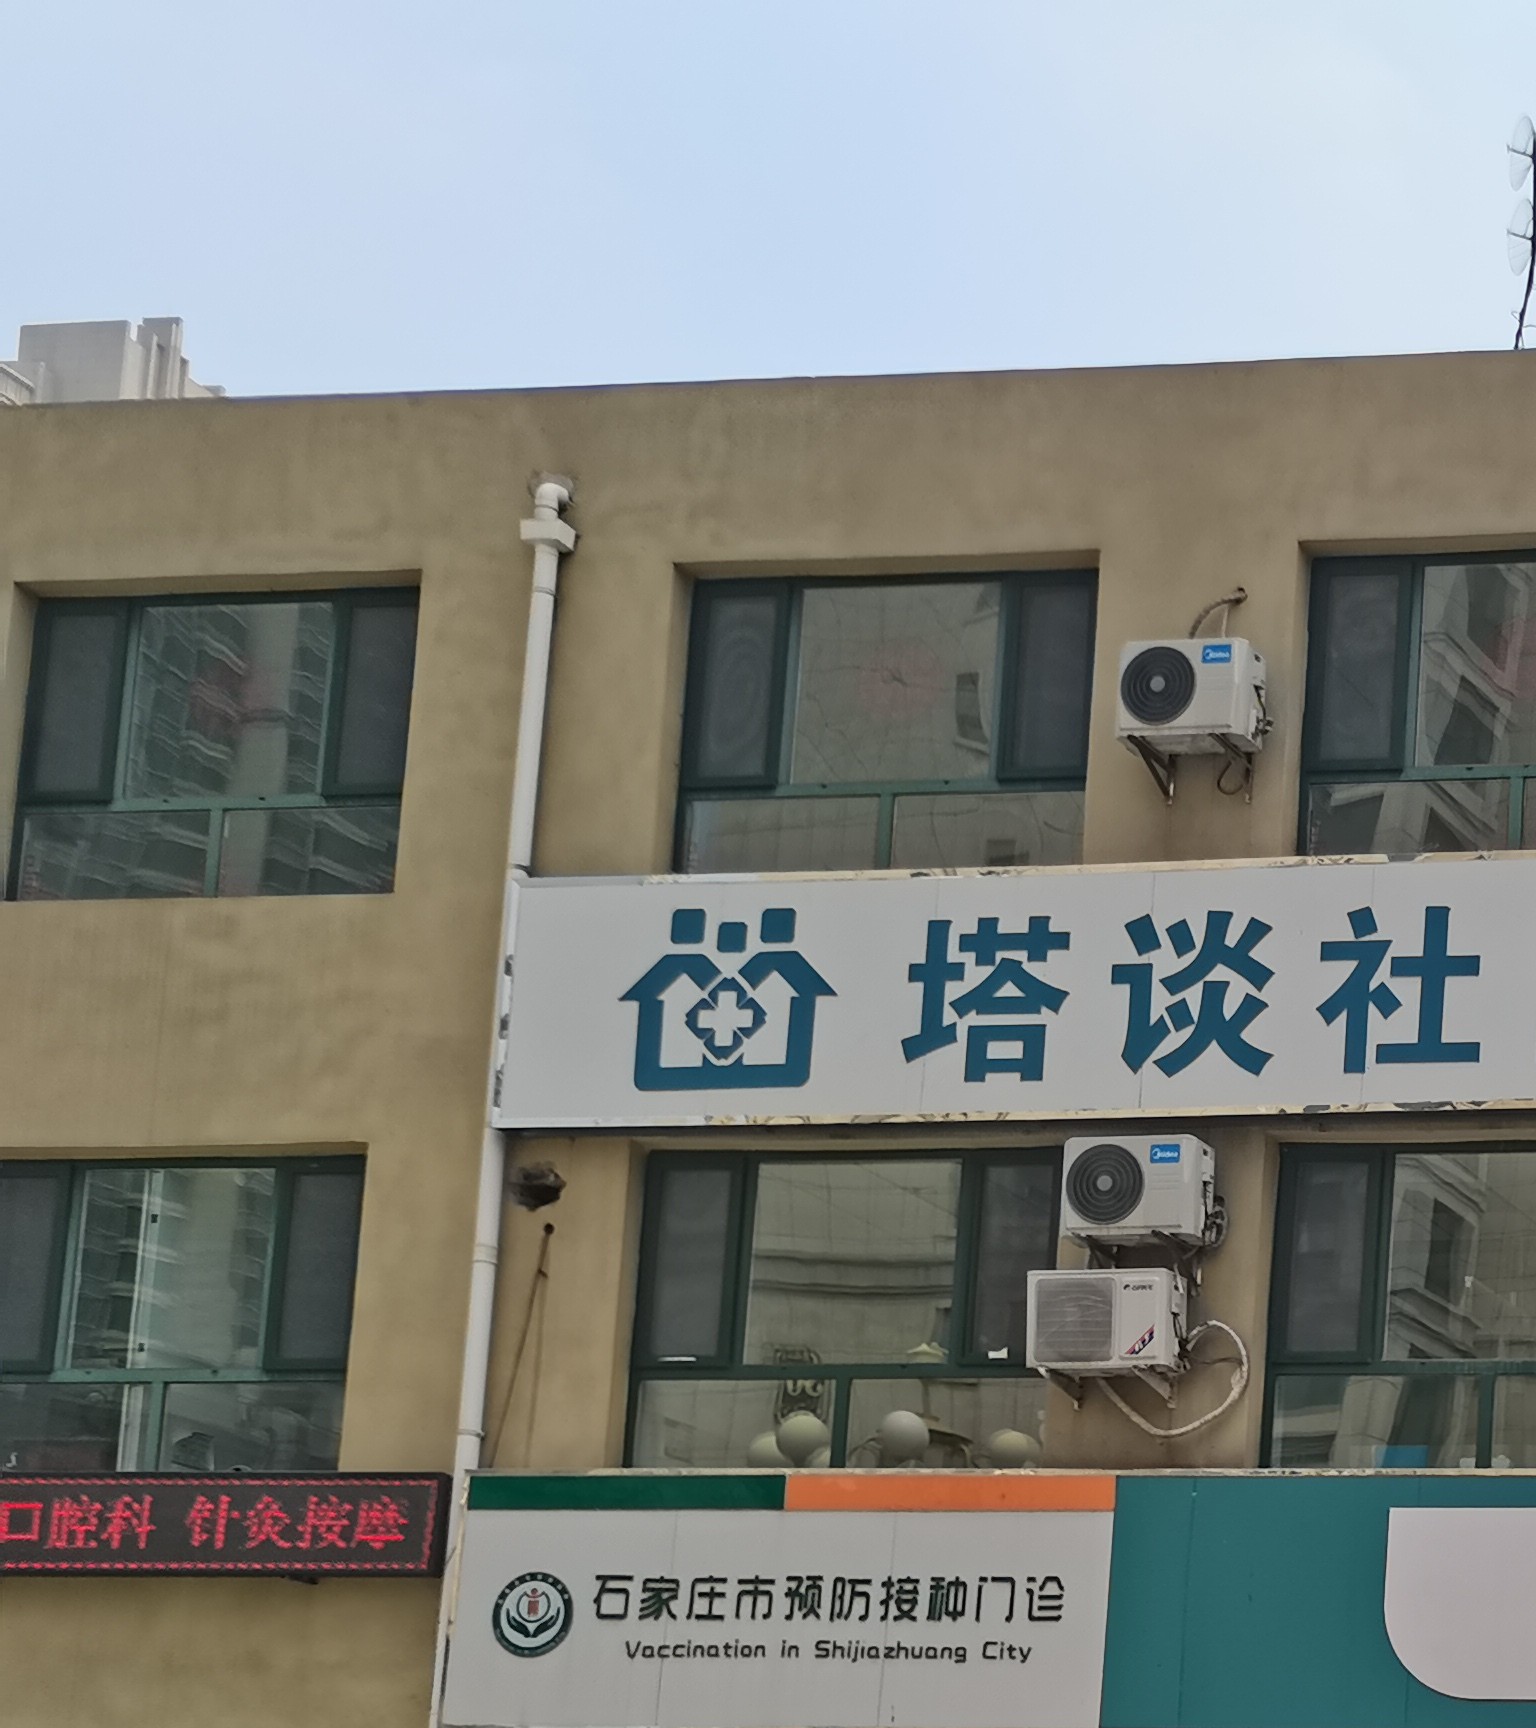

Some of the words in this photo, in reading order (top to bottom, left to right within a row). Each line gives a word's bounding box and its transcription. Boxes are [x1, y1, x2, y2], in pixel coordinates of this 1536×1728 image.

[0, 1494, 157, 1550] 口腔科
[184, 1494, 409, 1550] 针灸按摩
[592, 1574, 1066, 1624] 石家庄市预防接种门诊
[625, 1640, 766, 1660] Vaccination
[781, 1641, 800, 1658] in
[814, 1641, 968, 1663] Shijiazhuang
[981, 1641, 1032, 1663] City
